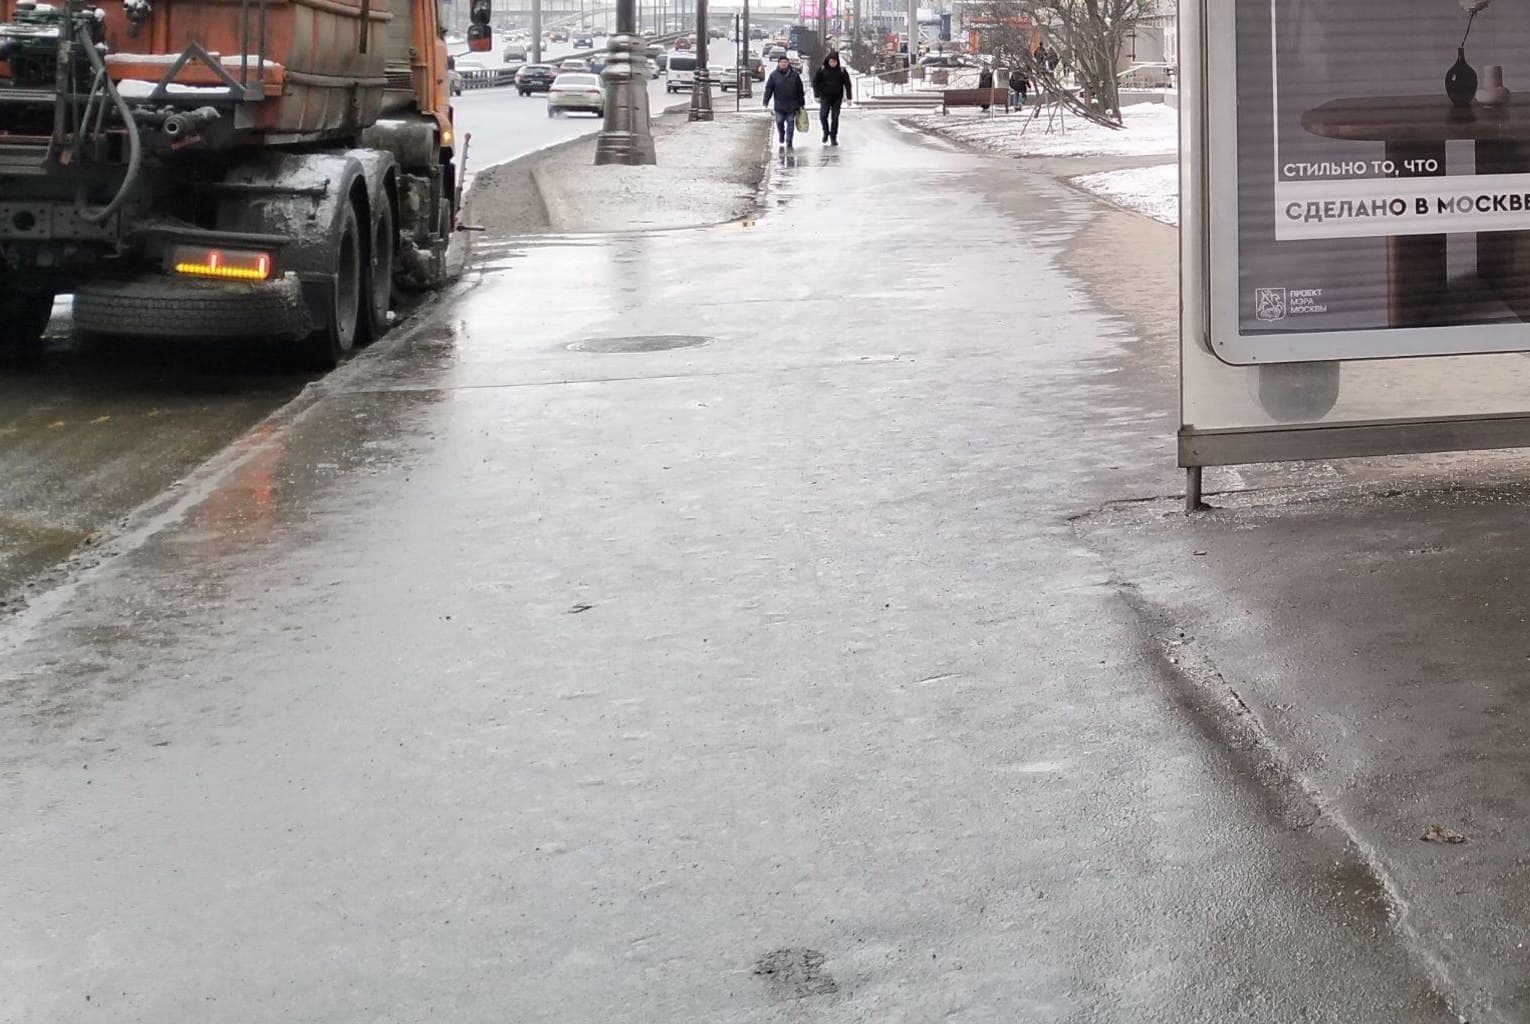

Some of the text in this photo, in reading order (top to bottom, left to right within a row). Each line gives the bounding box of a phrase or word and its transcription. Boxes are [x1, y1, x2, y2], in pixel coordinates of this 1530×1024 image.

[1283, 159, 1439, 177] СТИЛЬНО ТО, ЧТО
[1285, 198, 1407, 223] СДЕЛАНО
[1415, 197, 1429, 215] В
